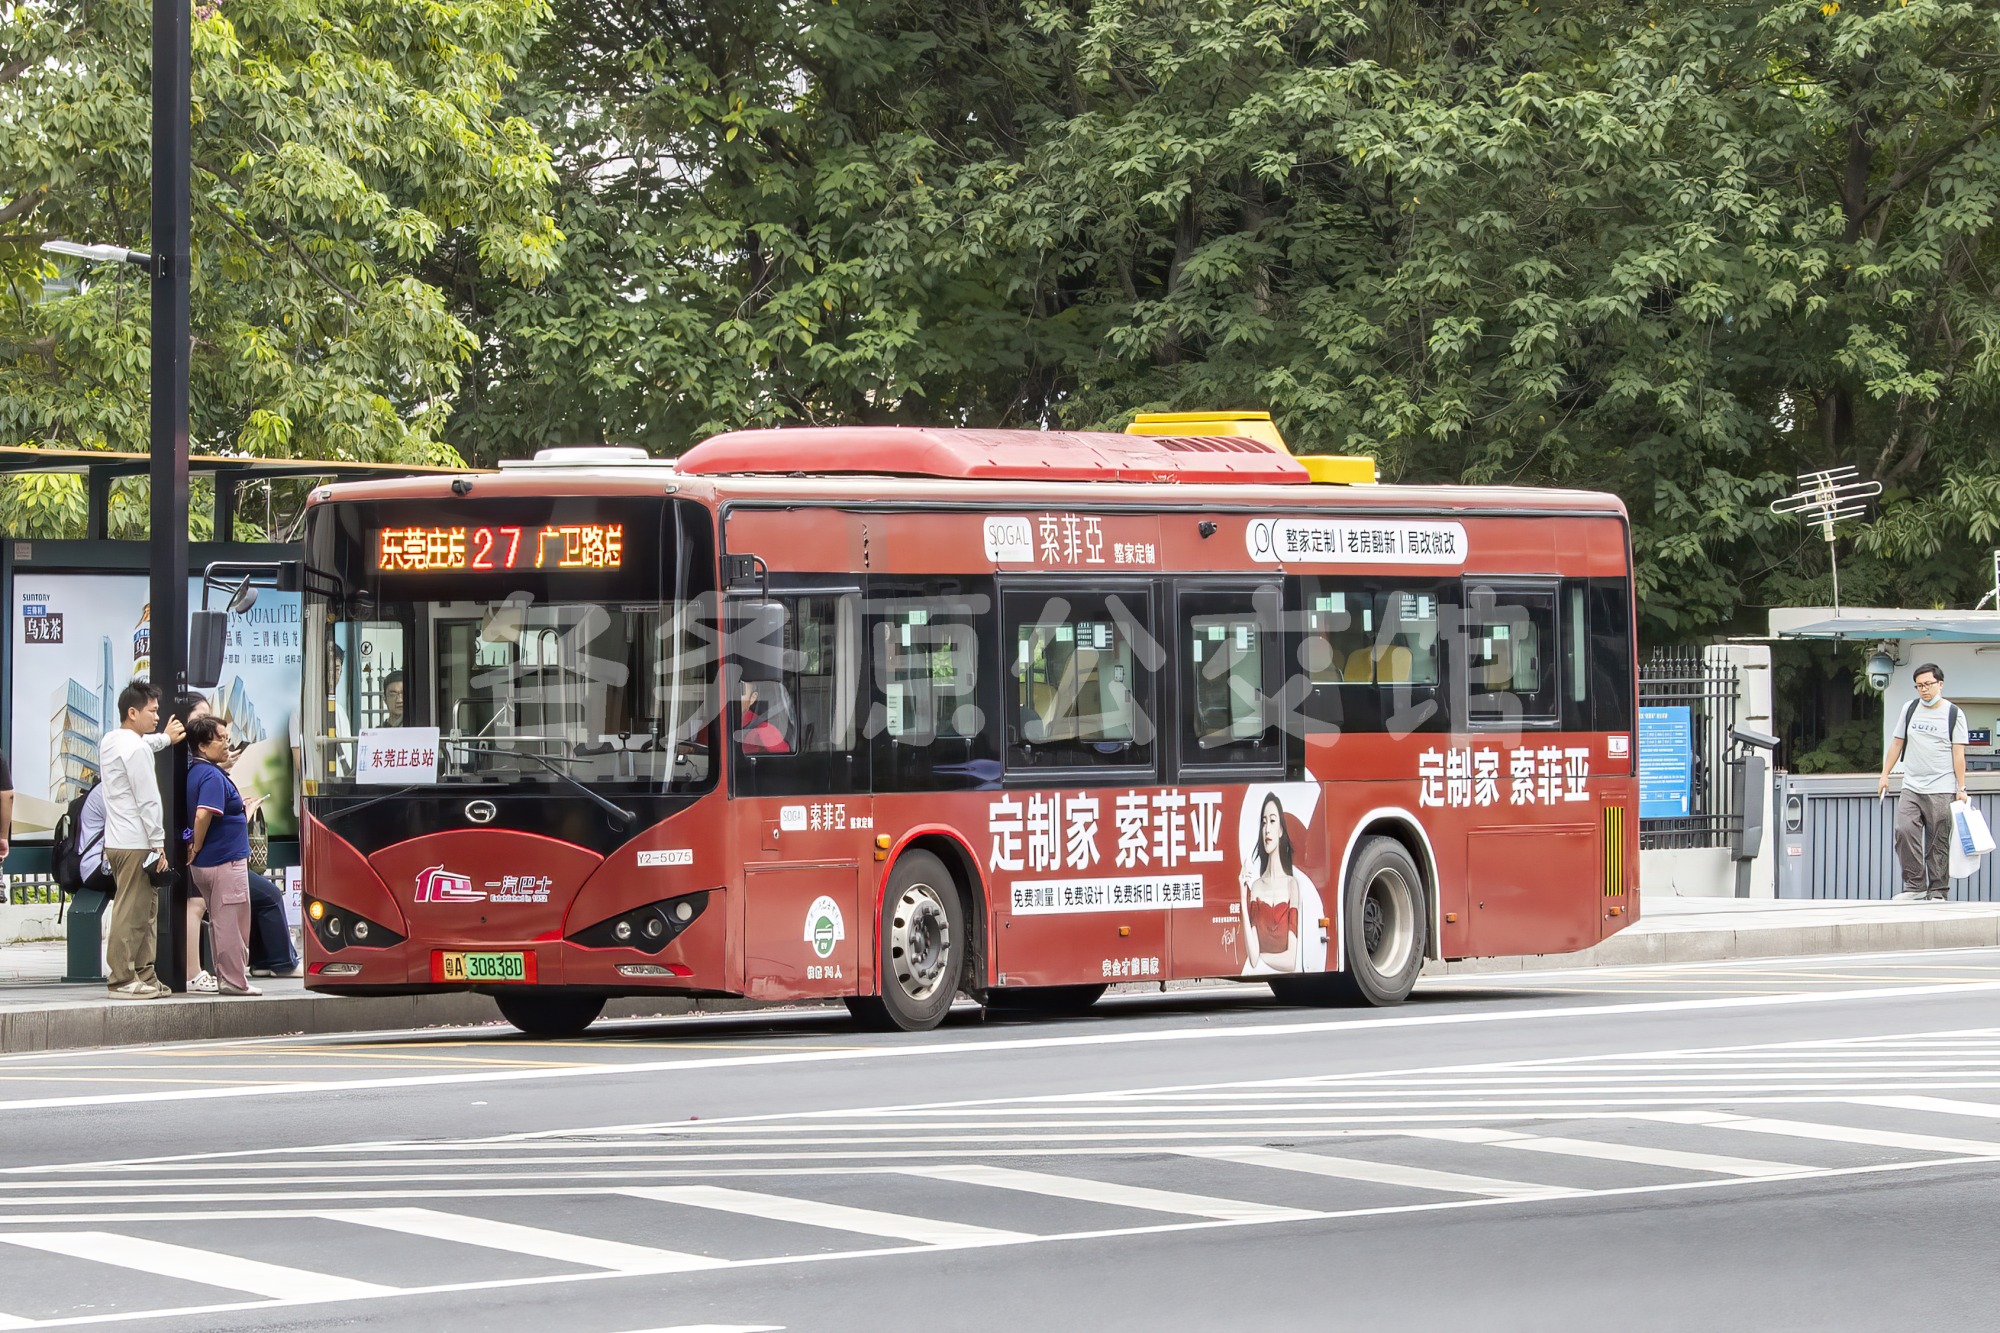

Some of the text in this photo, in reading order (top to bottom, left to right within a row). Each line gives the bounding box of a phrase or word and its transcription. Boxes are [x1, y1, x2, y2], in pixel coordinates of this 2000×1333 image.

[988, 524, 1030, 546] SOGAL
[1038, 512, 1156, 565] 索菲亞 整家定制
[1285, 528, 1456, 555] 整家定制 老房翻新 局改微改
[471, 525, 522, 570] 27
[22, 593, 51, 602] SUNTORY
[26, 617, 62, 640] 乌龙茶
[371, 748, 435, 769] 东莞庄总站
[1419, 746, 1500, 809] 定制家
[1509, 745, 1590, 806] 索菲亚
[810, 802, 846, 832] 索菲亞
[989, 788, 1224, 873] 定制家 索菲亚
[638, 851, 692, 864] Y2-5075
[485, 876, 553, 895] 一汽巴士
[1013, 882, 1201, 908] 免费测量 免费设计 免费拆旧 免费清运
[1102, 956, 1160, 977] 安全才能回家
